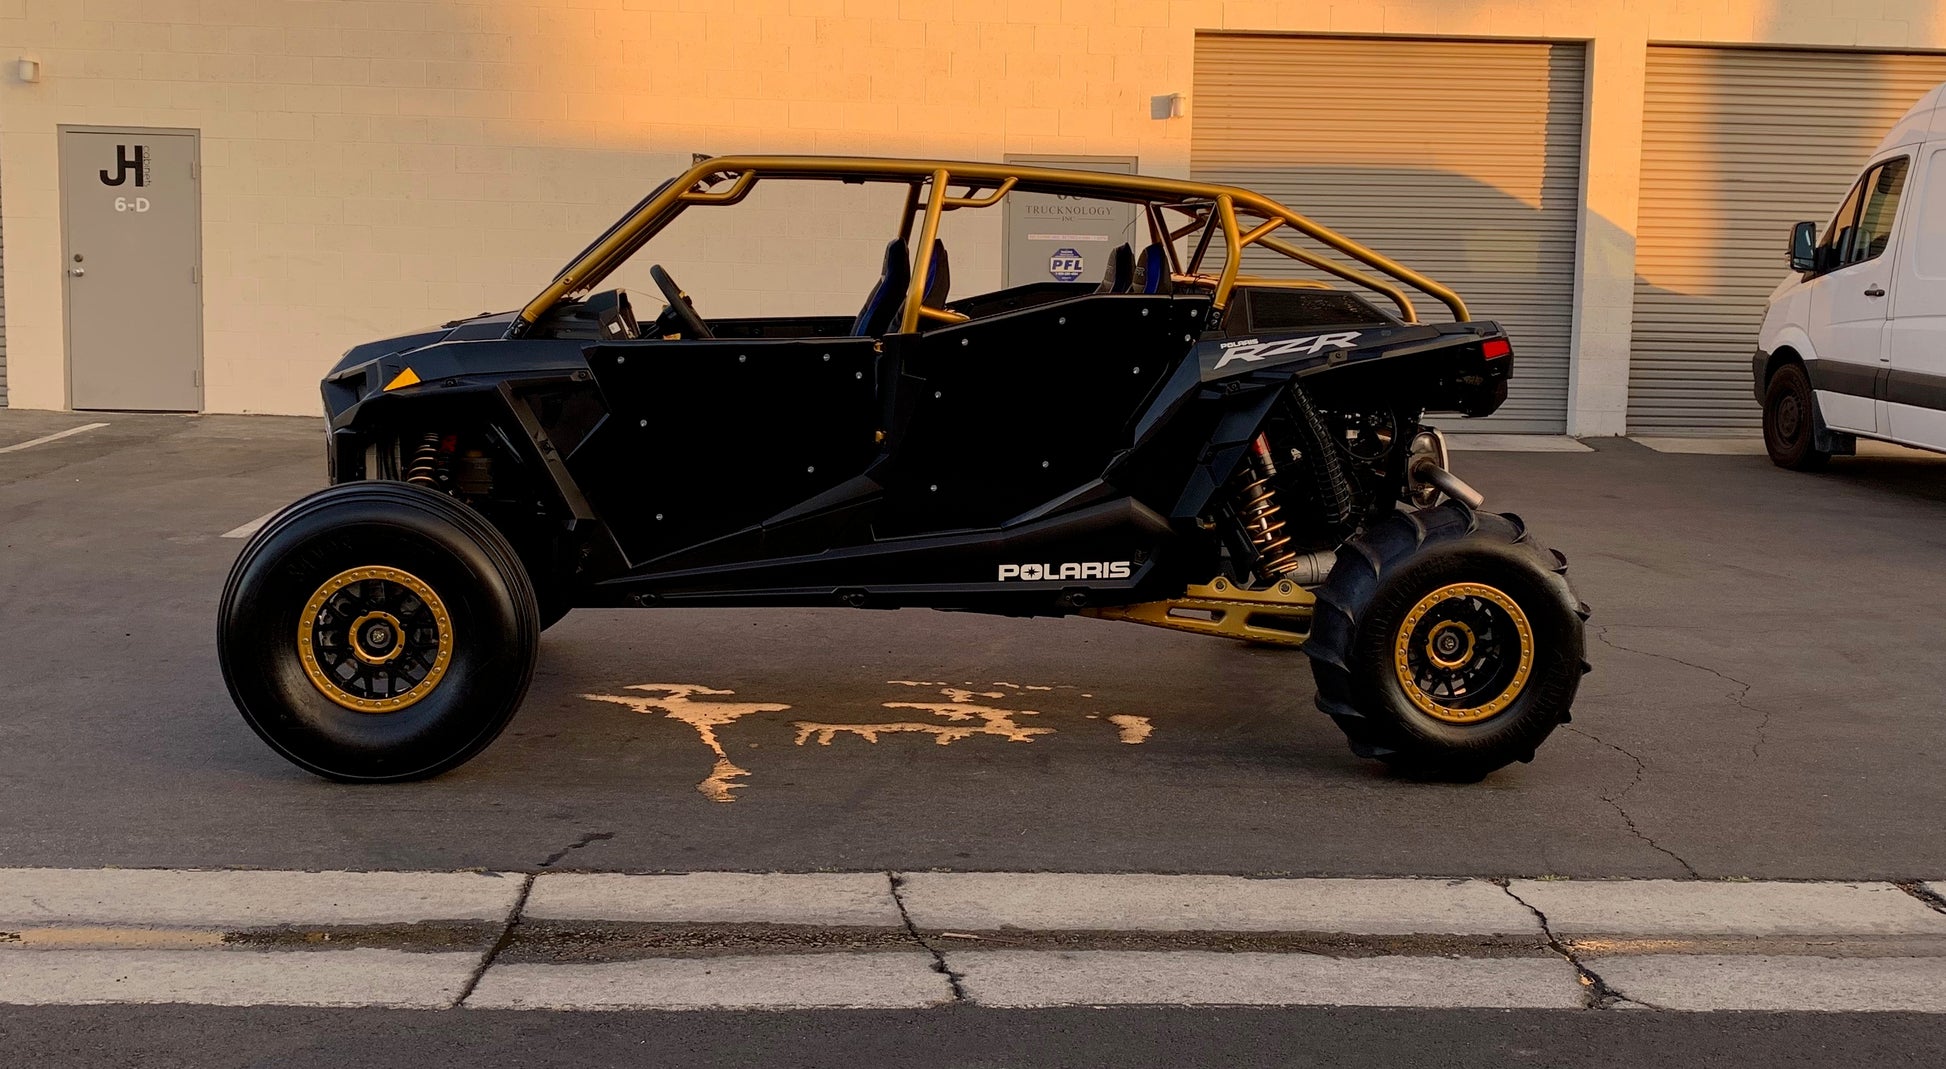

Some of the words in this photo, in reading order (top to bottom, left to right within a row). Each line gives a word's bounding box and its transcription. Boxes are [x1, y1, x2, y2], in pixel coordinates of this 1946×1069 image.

[100, 145, 144, 187] JH
[115, 197, 150, 212] 6-D
[1026, 205, 1113, 216] TRUCKNOLOGY
[1052, 260, 1083, 271] PFL
[1213, 331, 1363, 370] RZR
[1220, 338, 1259, 349] POLARIS
[998, 561, 1131, 581] POLARIS
